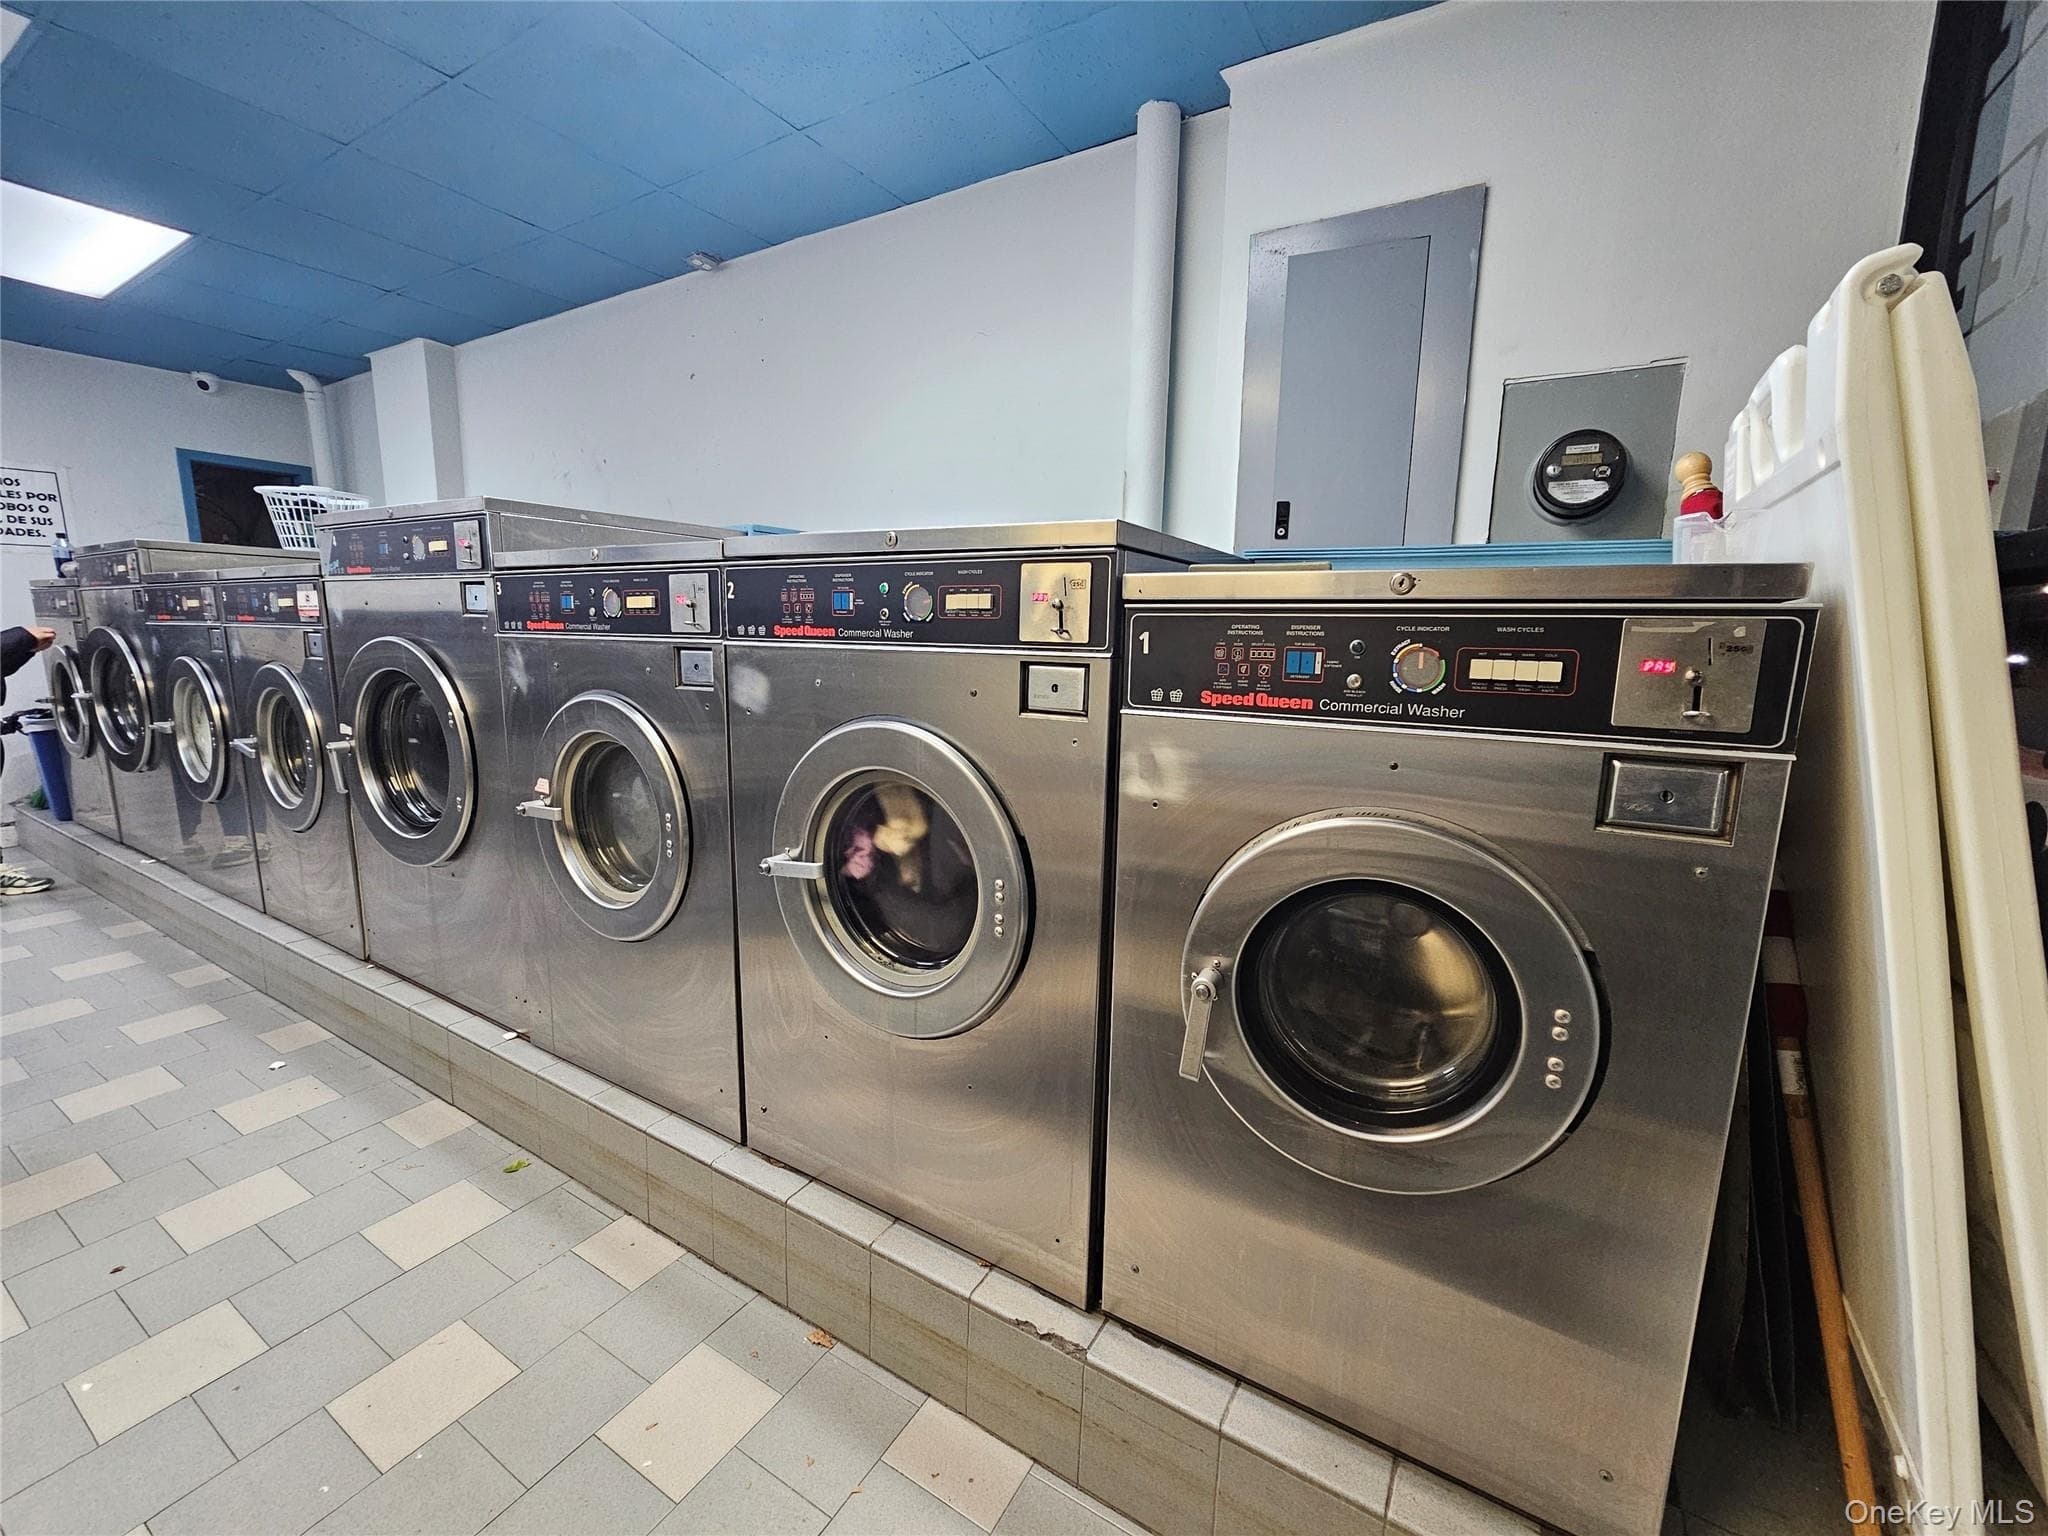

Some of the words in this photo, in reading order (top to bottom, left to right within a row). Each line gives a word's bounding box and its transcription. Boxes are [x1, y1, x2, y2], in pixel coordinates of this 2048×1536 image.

[26, 492, 57, 502] POR
[38, 505, 49, 513] O
[6, 515, 27, 524] DE
[30, 517, 53, 526] SUS
[727, 581, 735, 599] 2
[593, 623, 610, 631] Washer
[773, 625, 803, 638] Speed
[804, 625, 836, 637] Queen
[838, 627, 882, 638] Commercial
[883, 627, 914, 639] Washer
[1138, 631, 1150, 654] 1
[1642, 659, 1676, 673] PAY
[1200, 690, 1254, 707] Speed
[1255, 692, 1314, 710] Queen
[1319, 699, 1404, 715] Commercial
[1407, 702, 1466, 719] Washer
